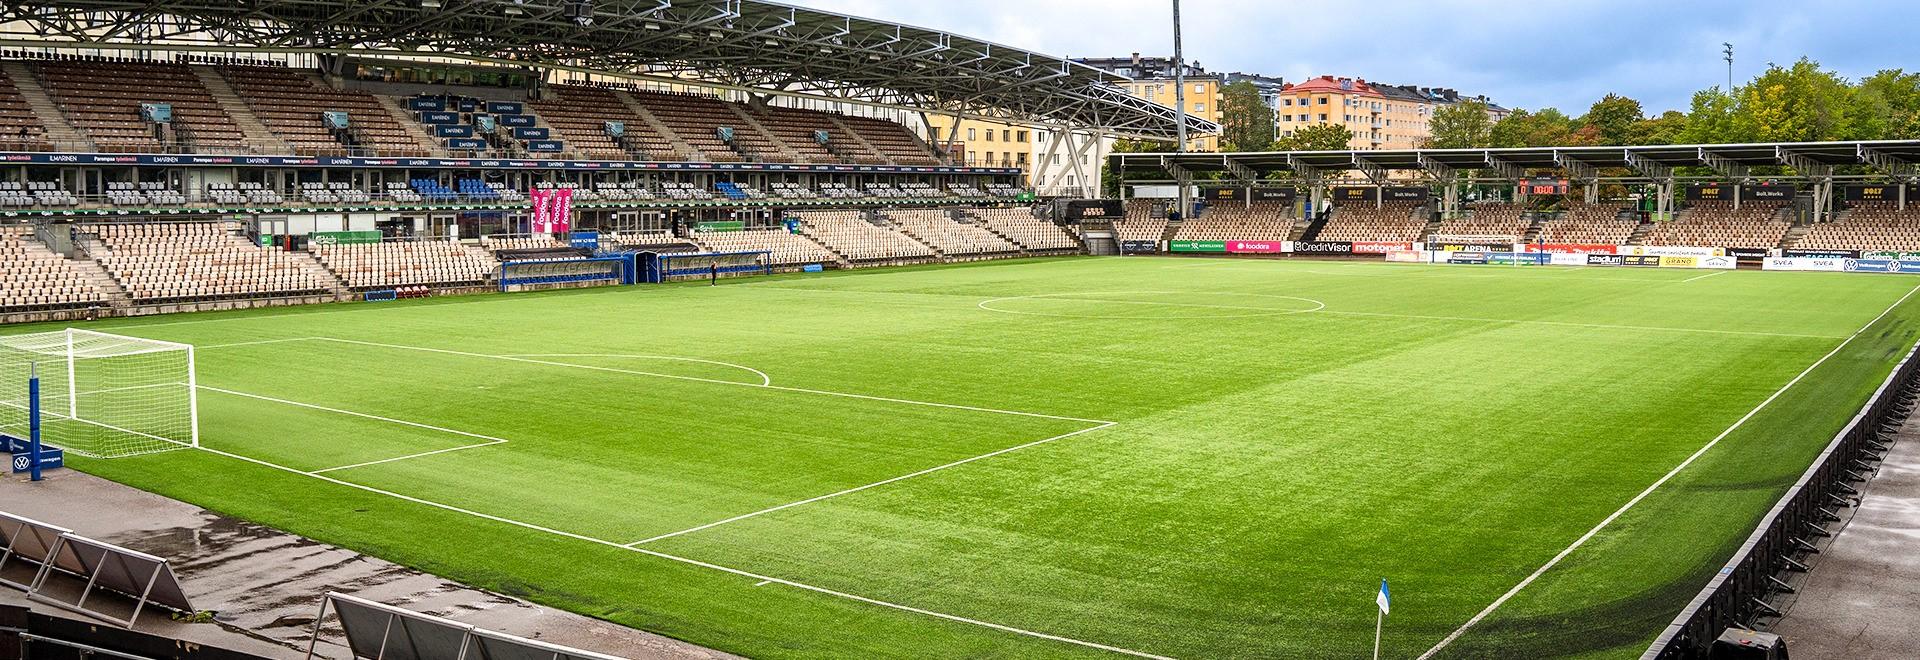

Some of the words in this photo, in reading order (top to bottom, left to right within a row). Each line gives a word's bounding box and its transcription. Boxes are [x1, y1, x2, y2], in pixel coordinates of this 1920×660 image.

[538, 197, 548, 225] foodora
[553, 196, 562, 224] foodora
[1302, 242, 1351, 252] CreditVisor
[1355, 243, 1406, 253] motonet
